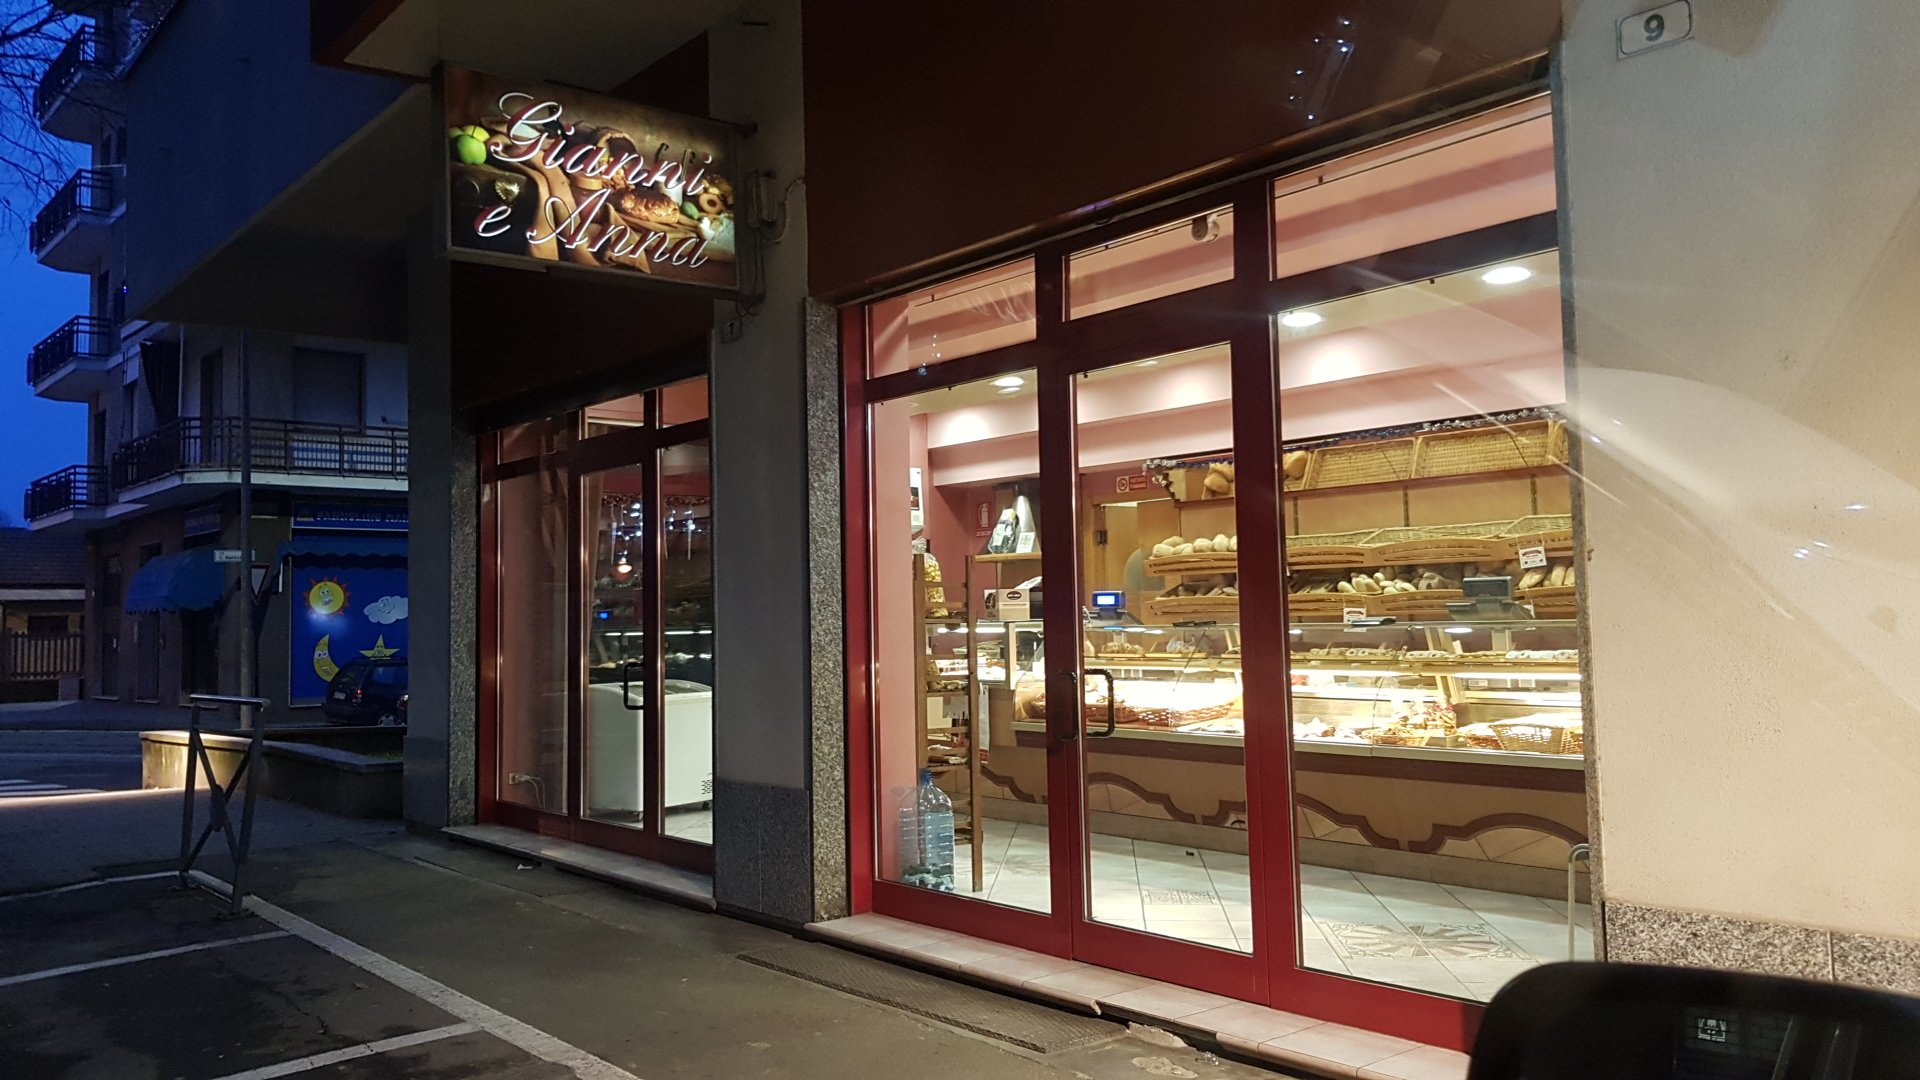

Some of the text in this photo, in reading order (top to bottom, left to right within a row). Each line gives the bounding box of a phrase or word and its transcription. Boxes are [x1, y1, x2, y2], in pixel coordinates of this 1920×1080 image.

[1644, 14, 1664, 42] 9
[490, 91, 713, 196] Gianni
[474, 188, 710, 268] e Anna
